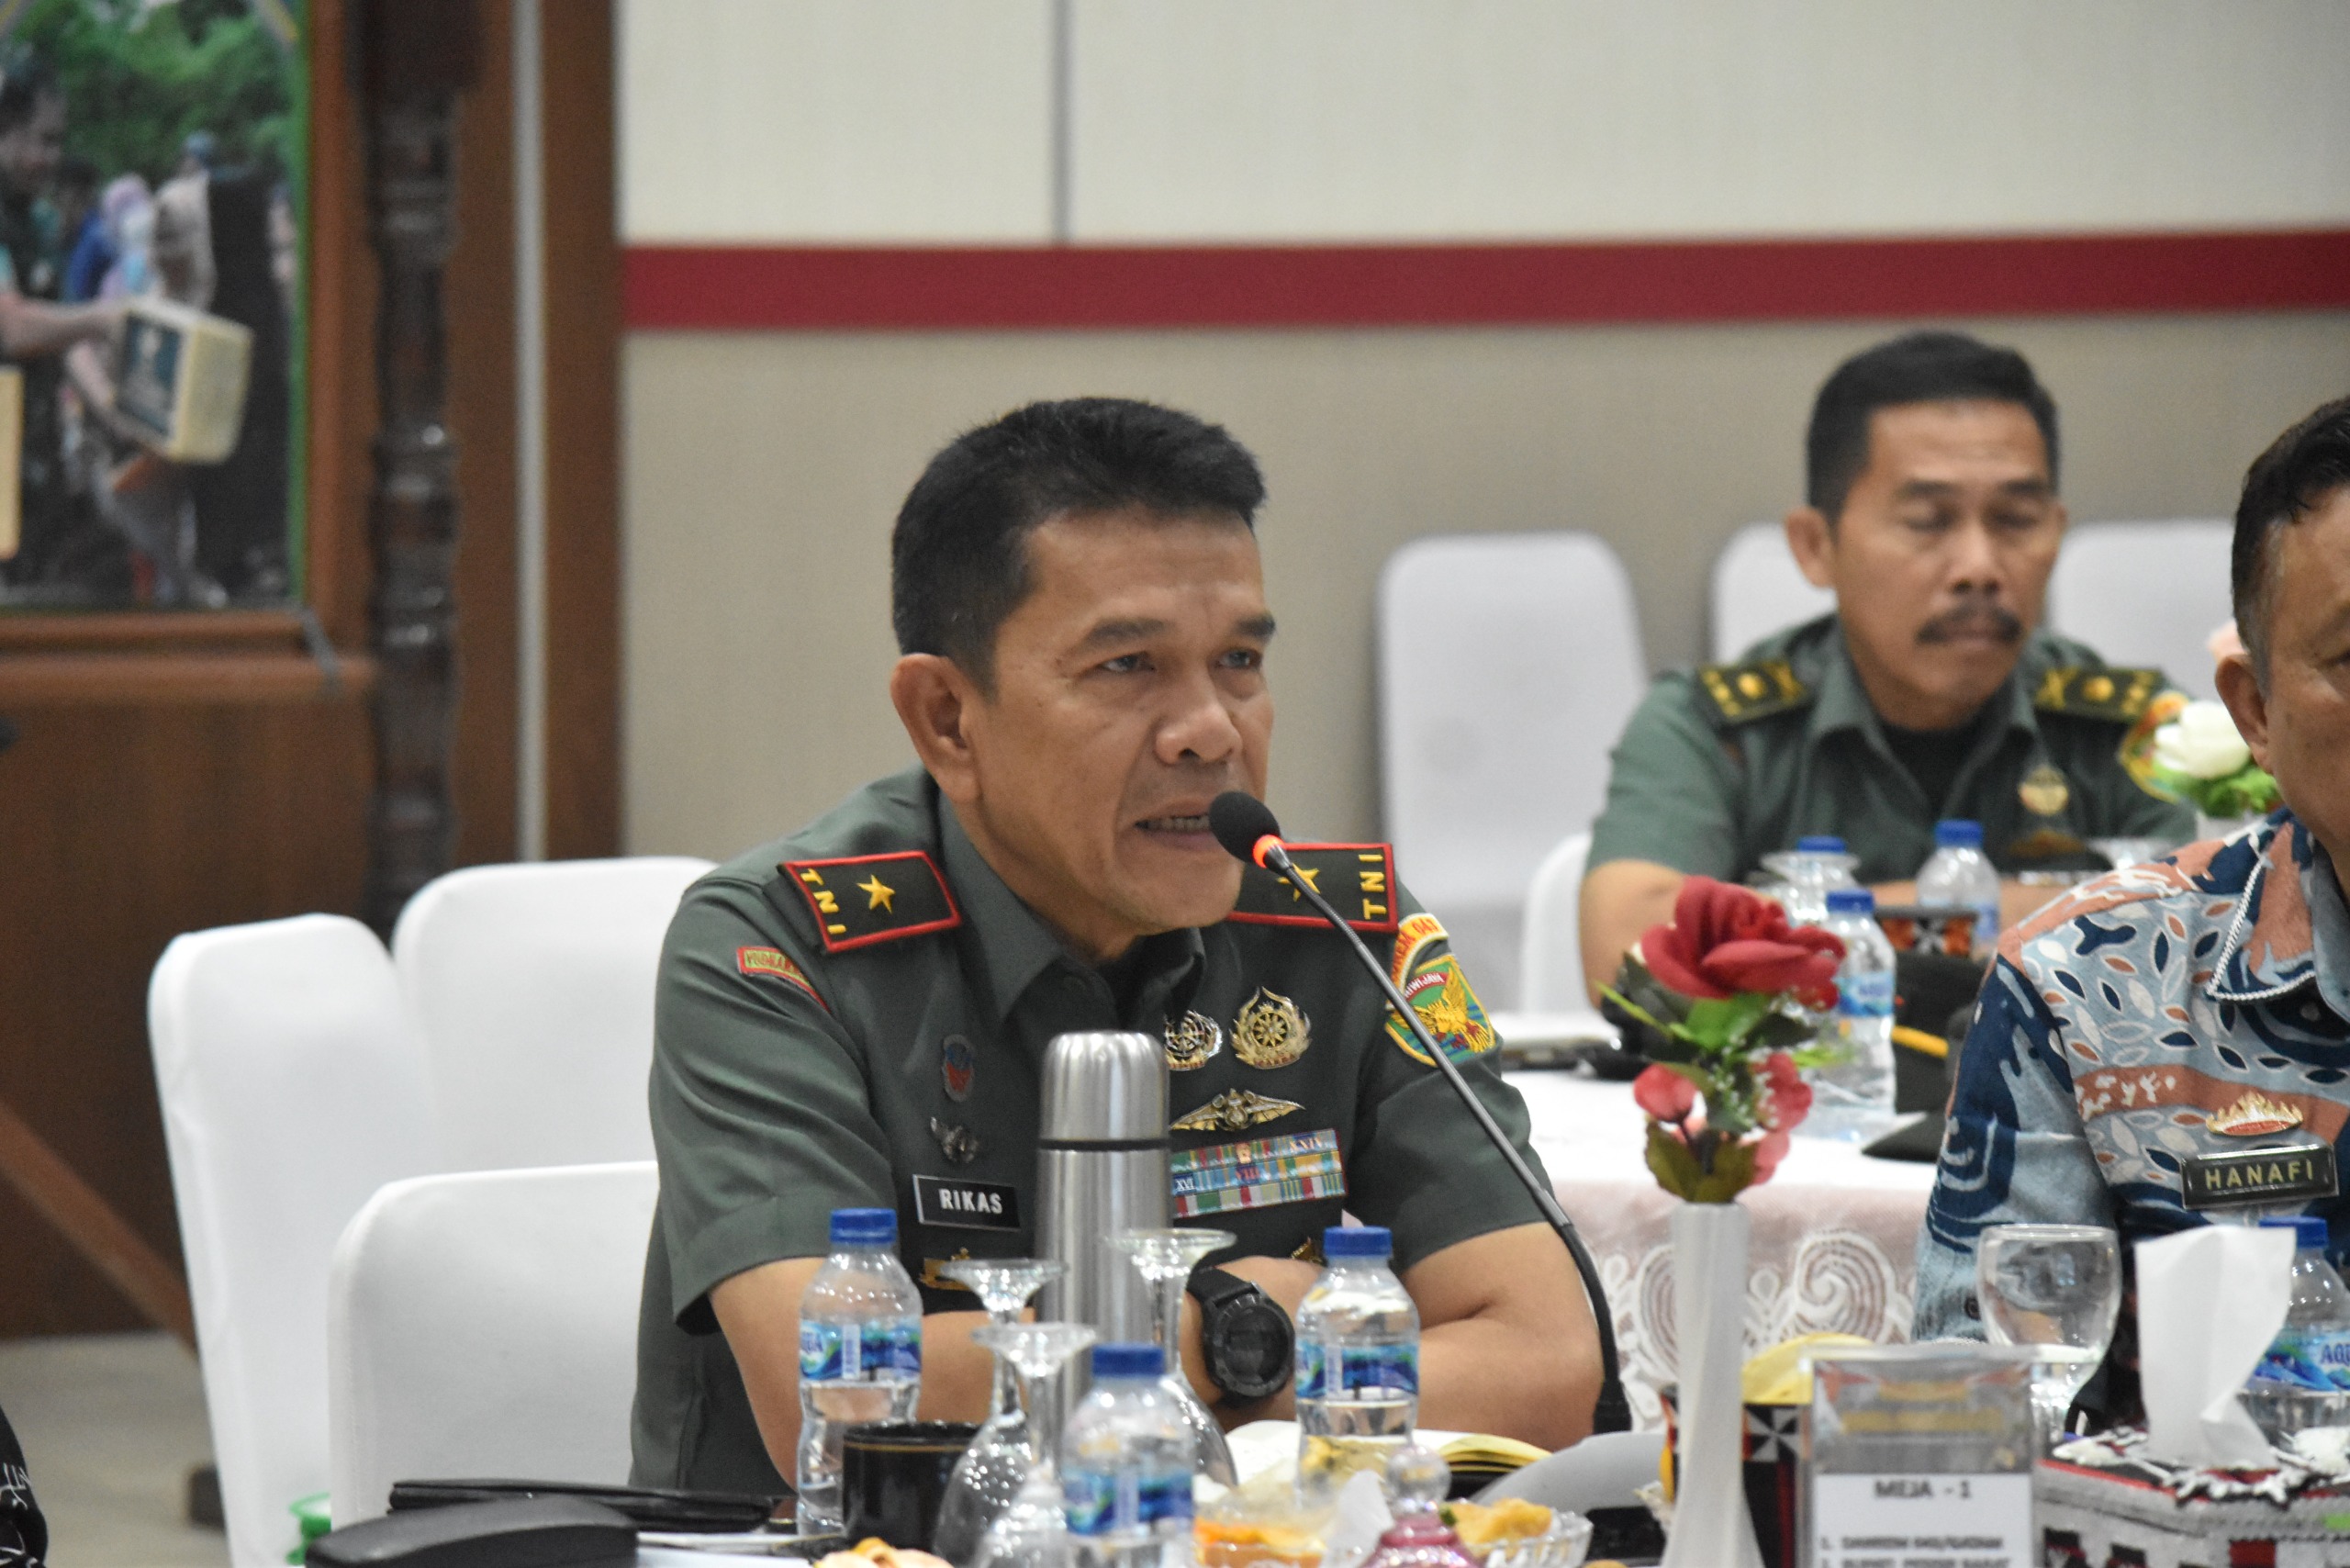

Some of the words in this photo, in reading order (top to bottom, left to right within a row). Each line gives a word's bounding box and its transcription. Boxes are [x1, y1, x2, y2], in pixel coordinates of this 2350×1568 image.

[800, 868, 846, 934] TNI
[1359, 854, 1386, 919] TNI
[1404, 972, 1445, 999] RIWIJAYA
[2205, 1159, 2312, 1190] HANAFI
[938, 1188, 1002, 1214] RIKAS
